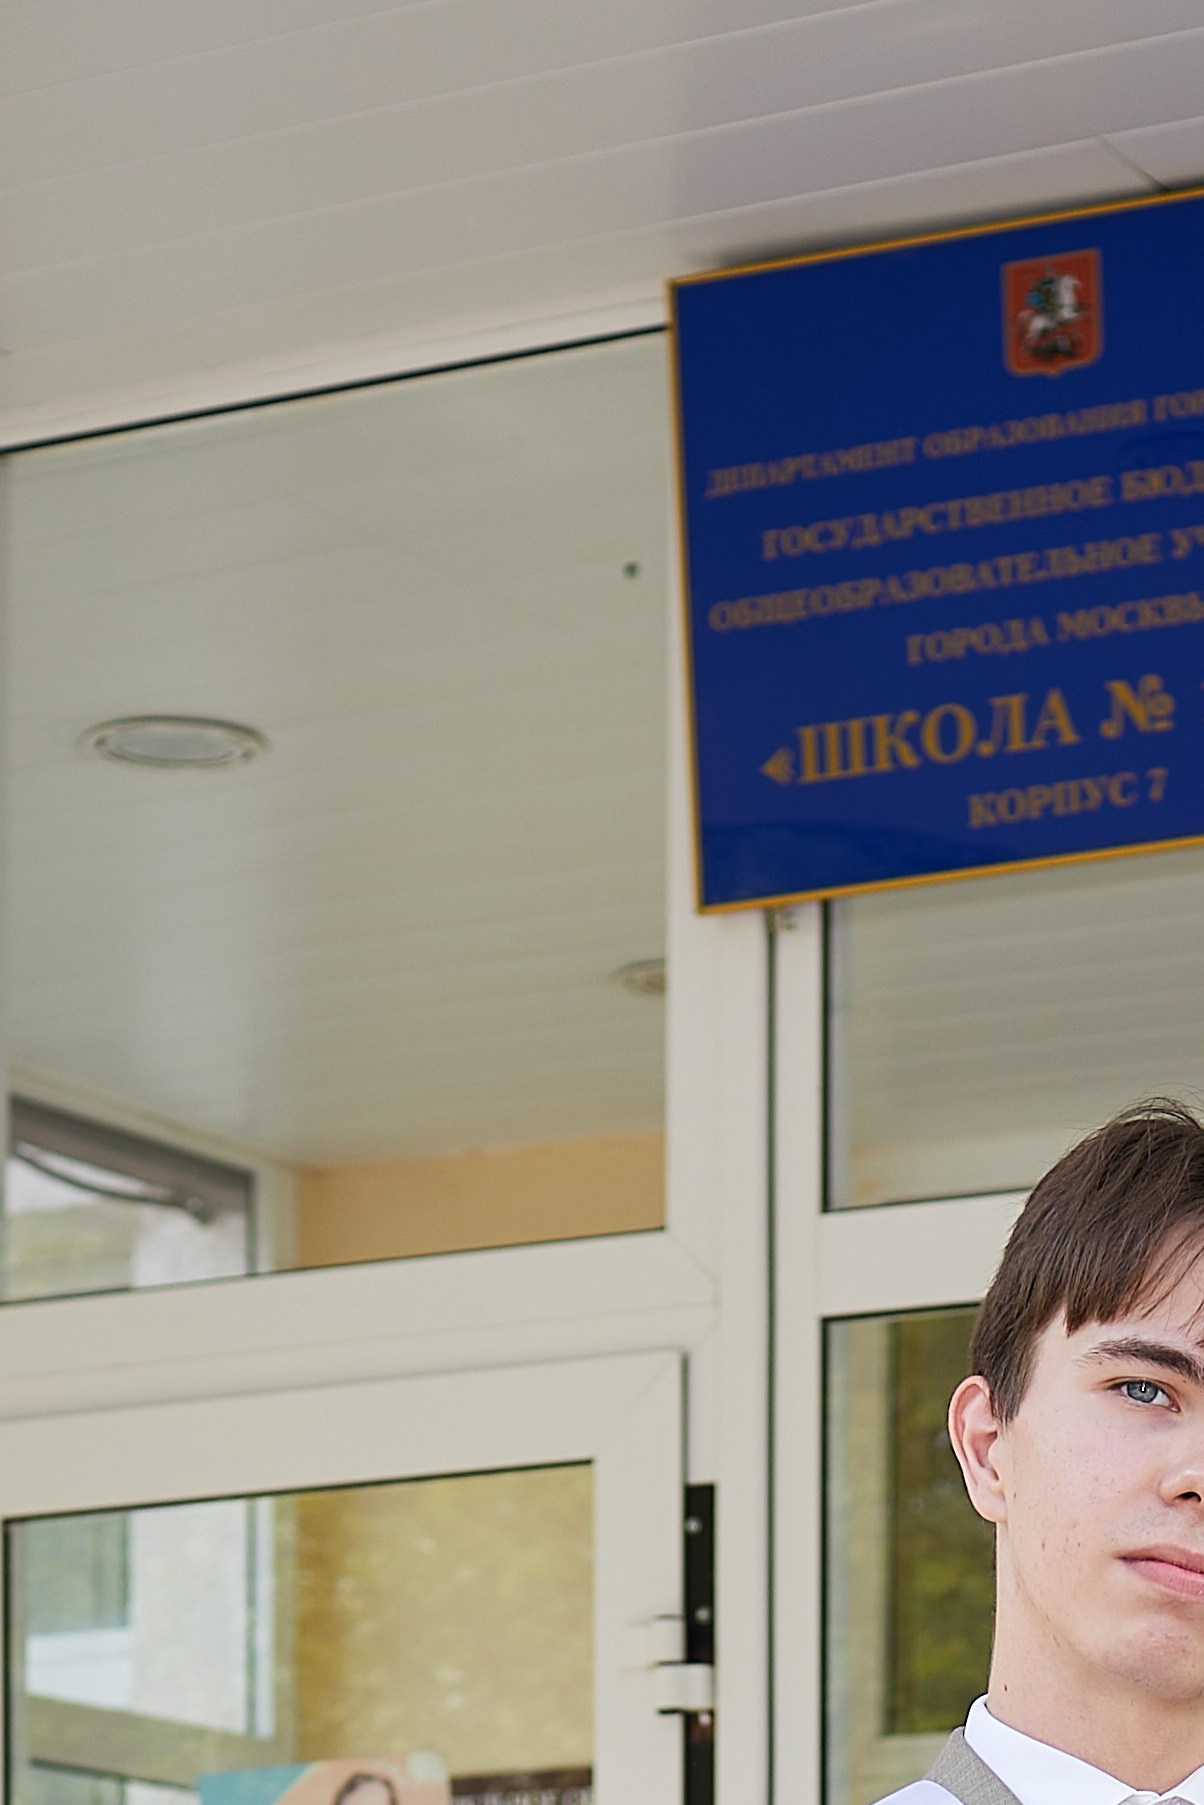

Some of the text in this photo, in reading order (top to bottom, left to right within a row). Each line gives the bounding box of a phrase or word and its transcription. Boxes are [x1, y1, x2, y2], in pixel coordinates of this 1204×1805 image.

[705, 436, 918, 498] ДЕПАРТАМЕНТ
[923, 400, 1147, 459] ОБРАЗОВАНИЯ
[762, 475, 1112, 560] ГОСУДАРСТВЕННОЕ
[708, 533, 1162, 632] ОБЩЕОБРАЗОВАТЕЛЬНОЕ
[906, 616, 1050, 666] ГОРОДА
[760, 688, 1082, 786] «ШКОЛА
[1100, 674, 1176, 740] №
[968, 768, 1169, 828] КОРПУС 7
